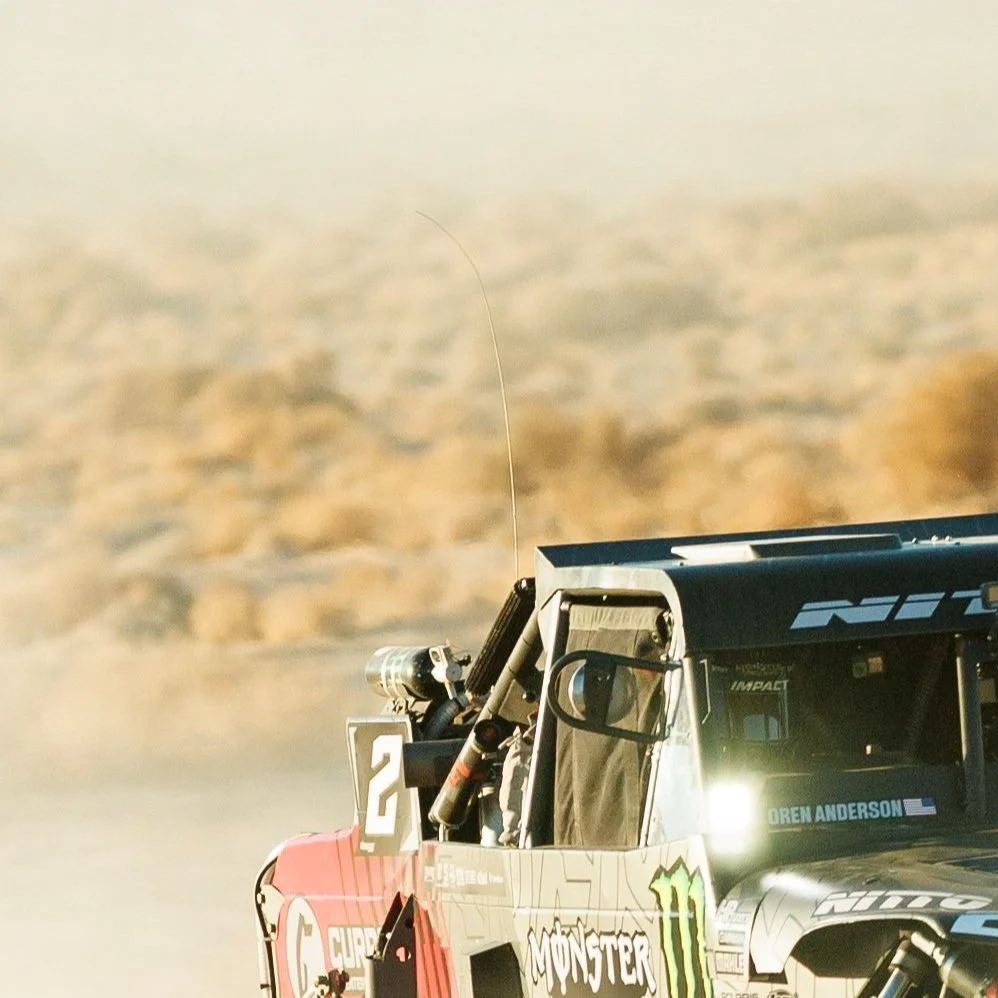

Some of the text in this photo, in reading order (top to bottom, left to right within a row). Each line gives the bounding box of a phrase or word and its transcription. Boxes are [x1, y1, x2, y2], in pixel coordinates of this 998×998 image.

[730, 679, 789, 691] IMPACT
[364, 734, 403, 836] 2
[766, 800, 904, 826] OREN ANDERSON
[812, 889, 994, 918] NITTO
[327, 926, 384, 970] CURR
